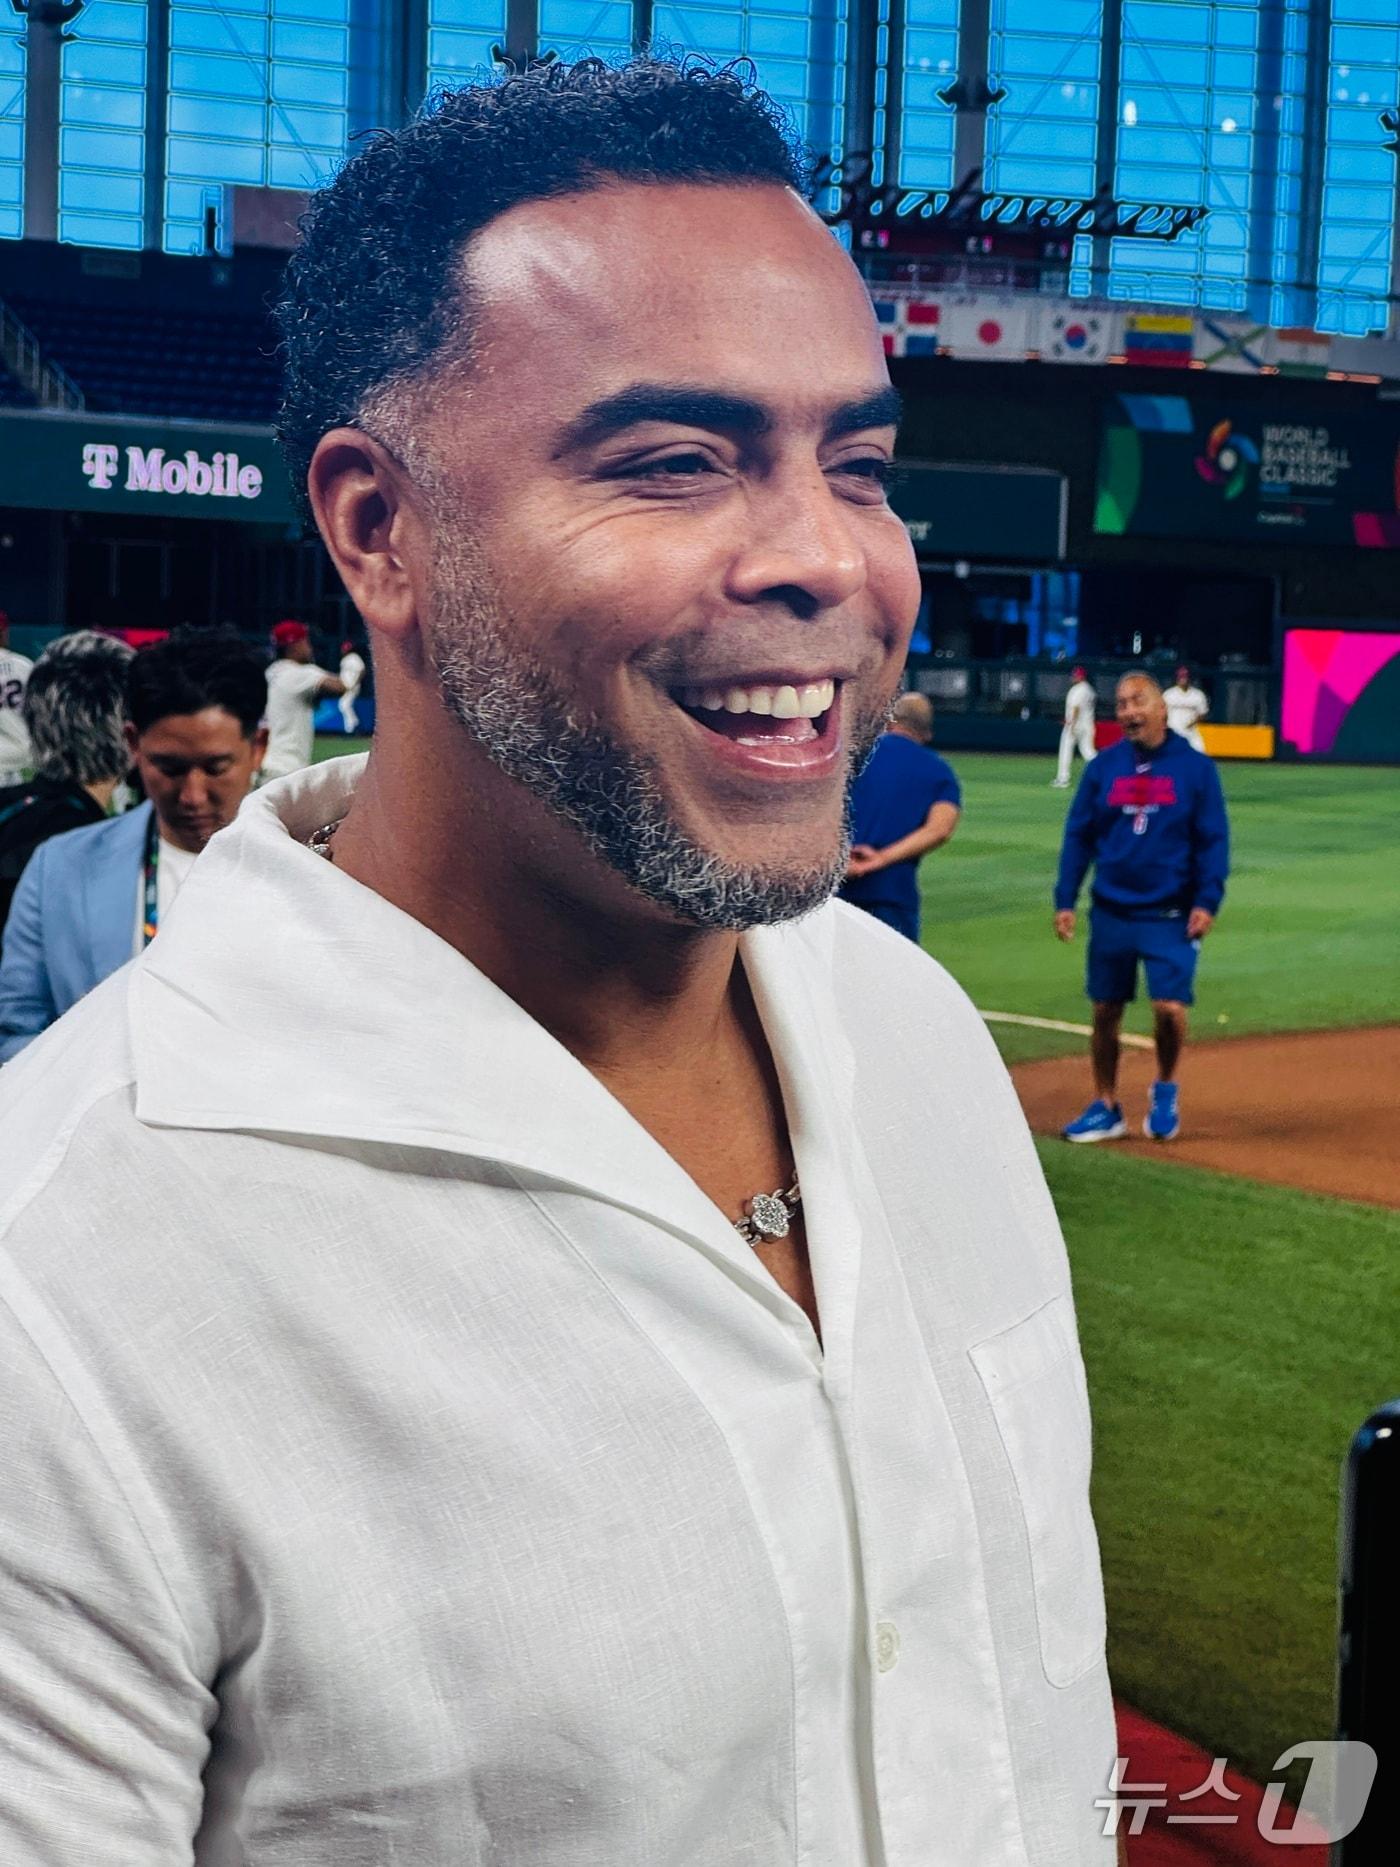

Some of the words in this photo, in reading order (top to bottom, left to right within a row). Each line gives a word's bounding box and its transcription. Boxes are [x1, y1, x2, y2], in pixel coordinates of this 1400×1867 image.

[1263, 425, 1329, 447] WORLD
[1262, 443, 1352, 469] BASEBALL
[82, 443, 118, 489] T
[124, 446, 263, 499] Mobile
[1259, 463, 1338, 487] CLASSIC
